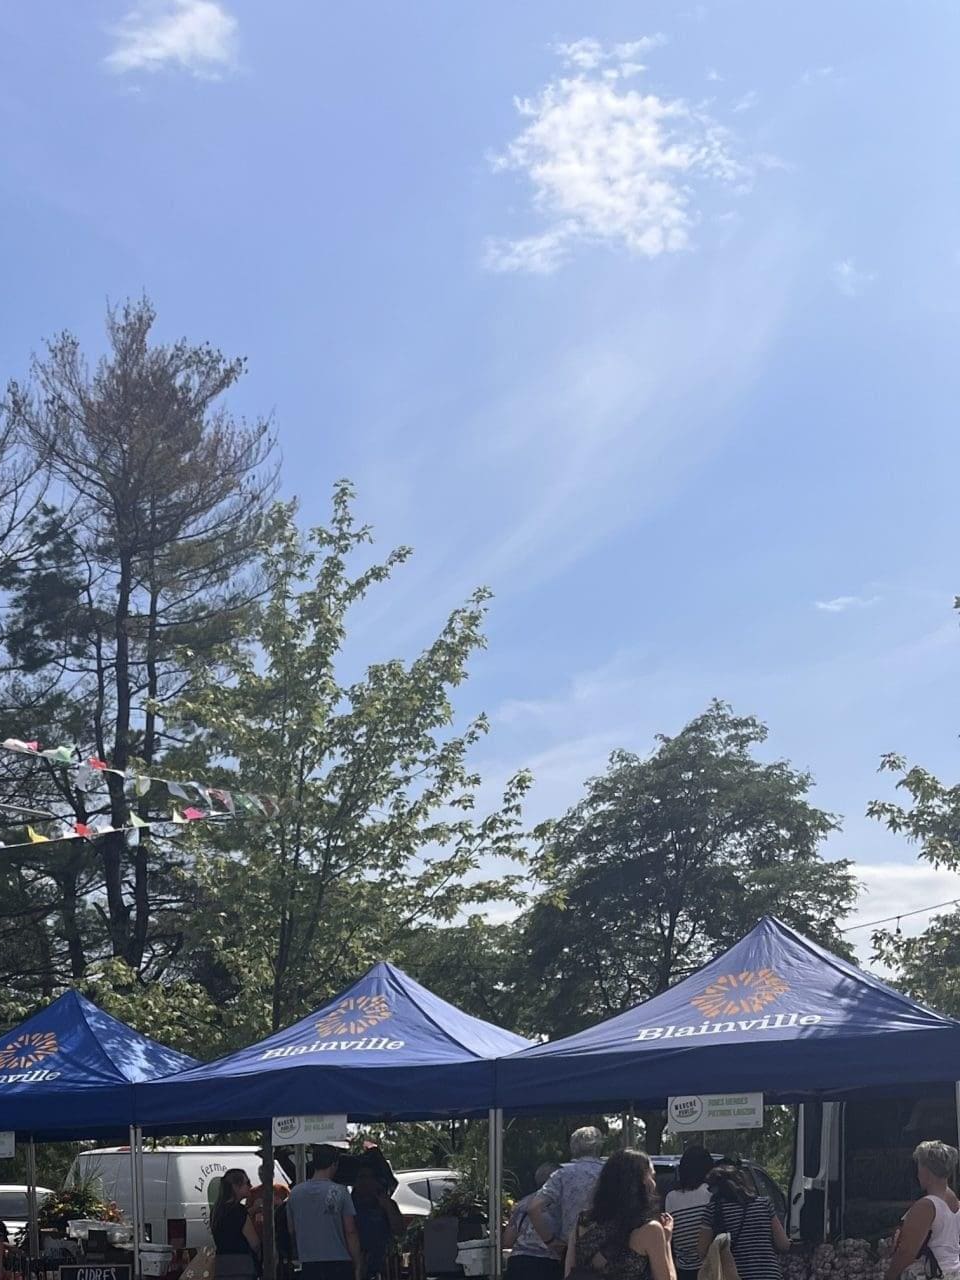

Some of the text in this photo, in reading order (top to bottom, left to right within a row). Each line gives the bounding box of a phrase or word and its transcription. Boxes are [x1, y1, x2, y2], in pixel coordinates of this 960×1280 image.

[632, 1013, 822, 1042] Blainville
[259, 1037, 406, 1060] Blainville
[194, 1163, 228, 1192] La ferme
